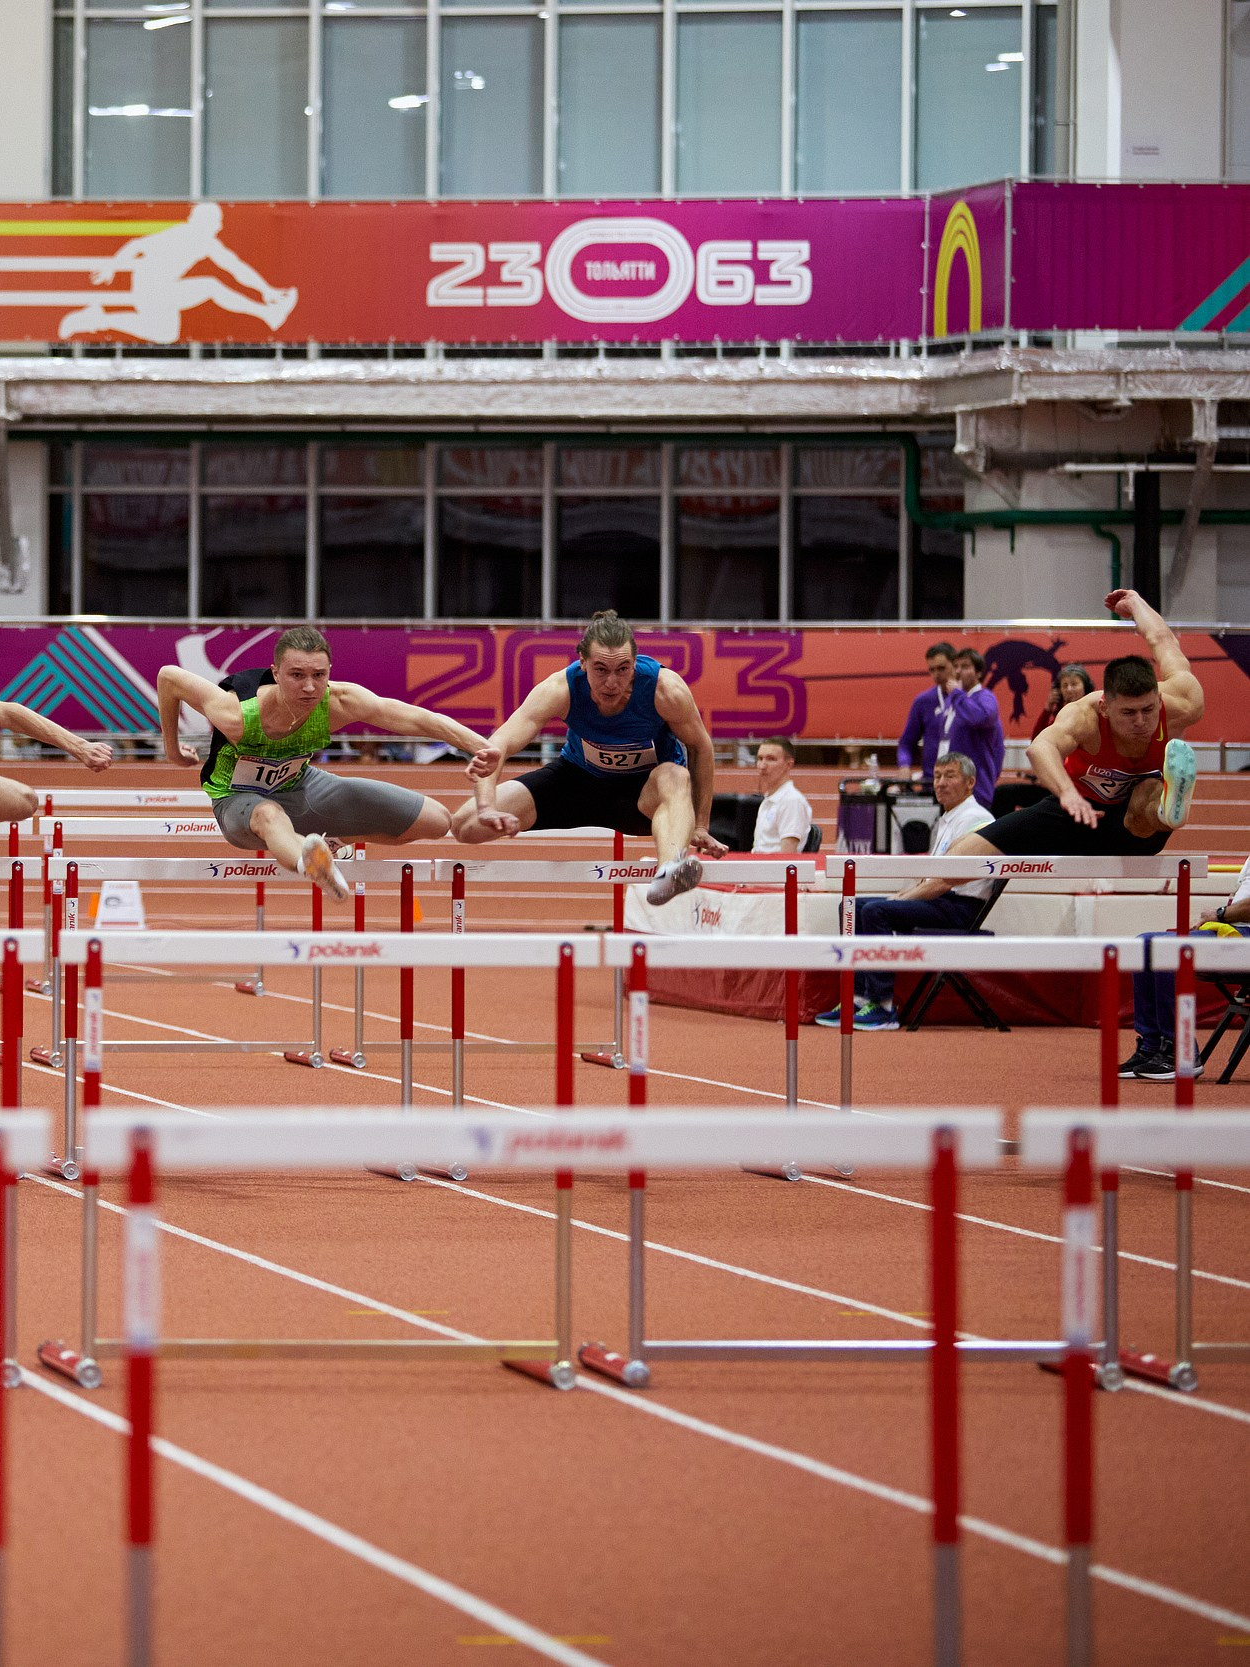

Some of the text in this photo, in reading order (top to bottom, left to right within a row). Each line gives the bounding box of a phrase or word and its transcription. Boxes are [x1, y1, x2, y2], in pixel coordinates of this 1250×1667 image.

[585, 261, 656, 281] ТОЛЬЯТТИ
[599, 751, 642, 767] 527
[256, 762, 292, 787] 105
[1094, 766, 1111, 777] U20
[175, 822, 217, 833] polanik
[223, 863, 277, 878] polanik
[1000, 860, 1054, 876] polanik
[845, 911, 853, 937] olanik
[308, 941, 382, 960] polanik
[851, 945, 926, 964] polanik
